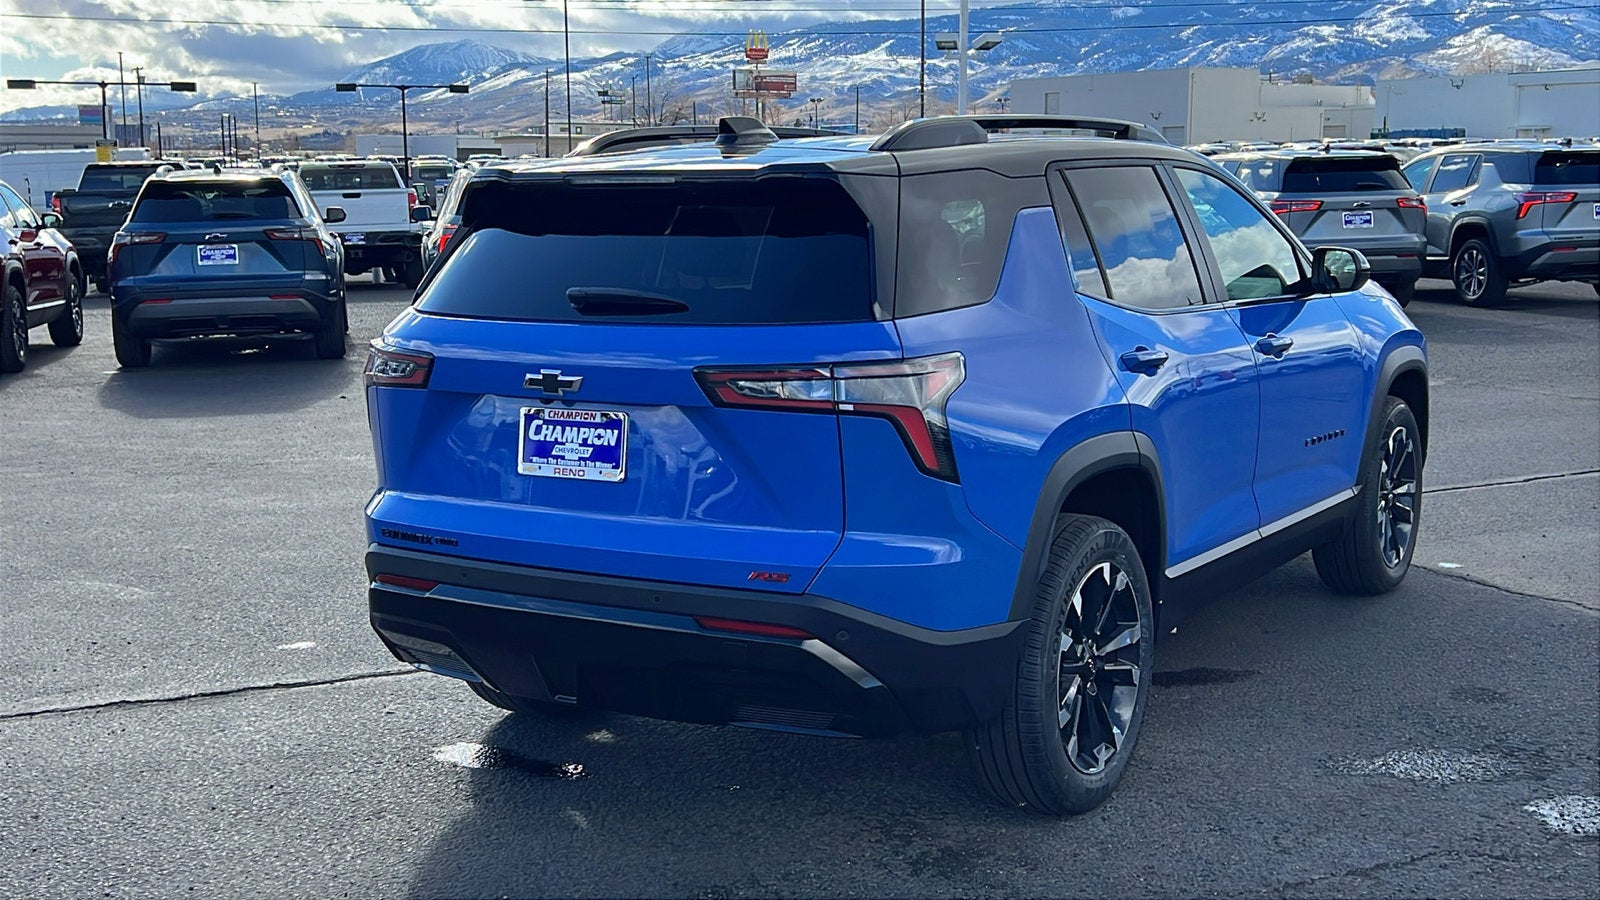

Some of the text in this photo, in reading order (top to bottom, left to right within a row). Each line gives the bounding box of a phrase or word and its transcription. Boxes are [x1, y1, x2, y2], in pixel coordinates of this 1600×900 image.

[548, 410, 597, 421] CHAMPION
[528, 419, 619, 446] CHAMPION
[554, 447, 590, 455] CHEVROLET
[548, 457, 557, 465] The
[553, 468, 585, 477] RENO
[747, 571, 789, 582] RS
[1051, 541, 1104, 673] CONTINENTAL
